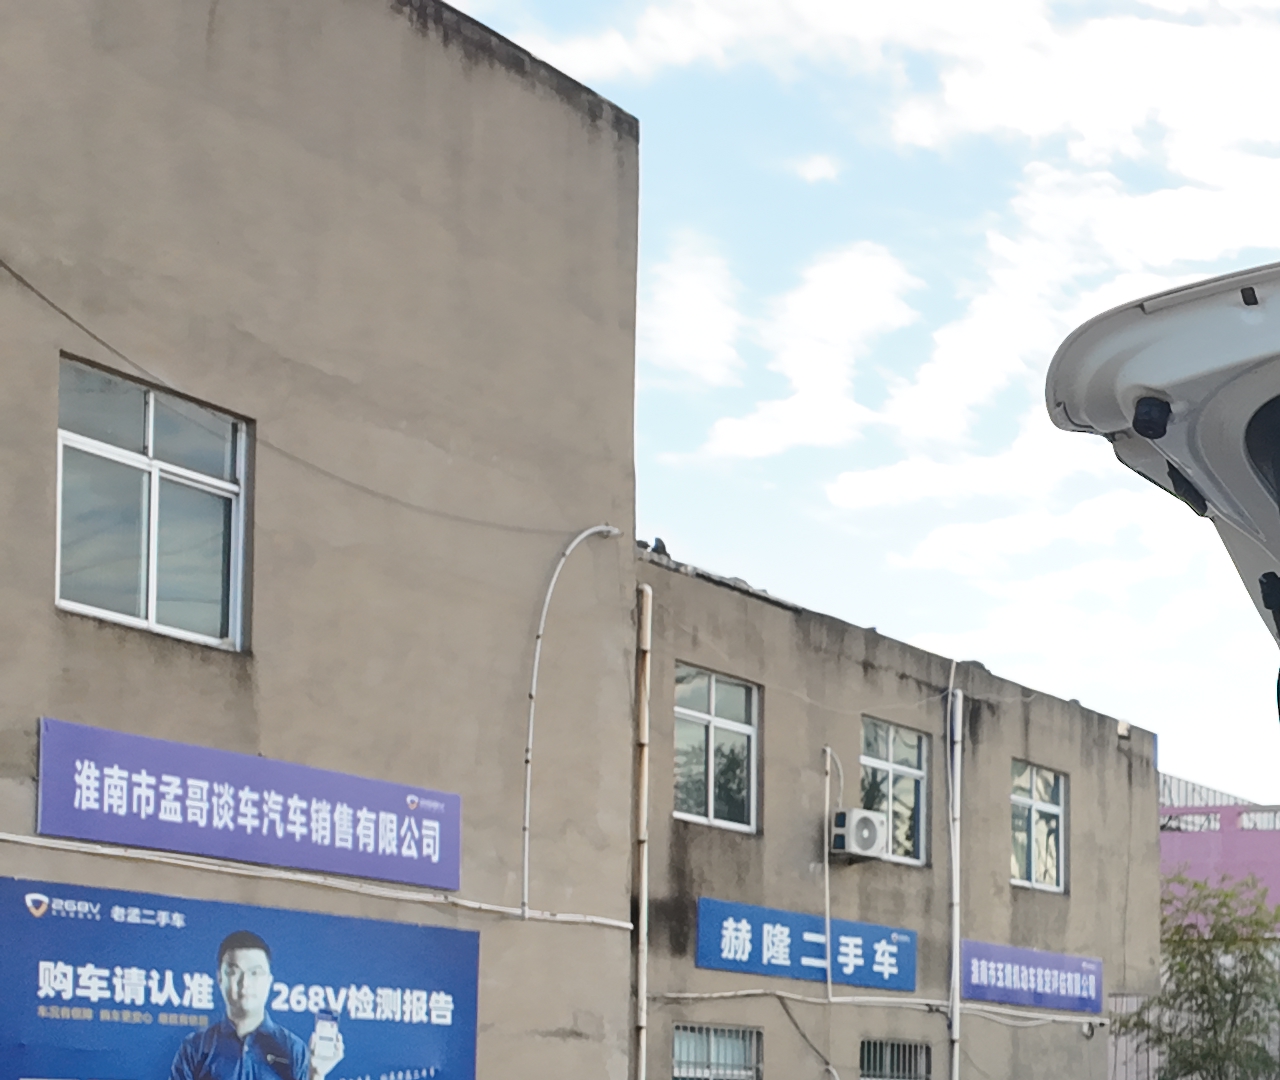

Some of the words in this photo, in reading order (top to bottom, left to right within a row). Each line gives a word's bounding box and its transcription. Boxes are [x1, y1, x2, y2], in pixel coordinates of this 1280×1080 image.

[74, 759, 440, 863] 淮南市孟哥谈车汽车销售有限公司
[110, 904, 186, 929] 老孟二手车
[720, 916, 899, 980] 赫隆二手车
[37, 960, 215, 1010] 购车请认准
[271, 982, 455, 1026] 268V检测报告
